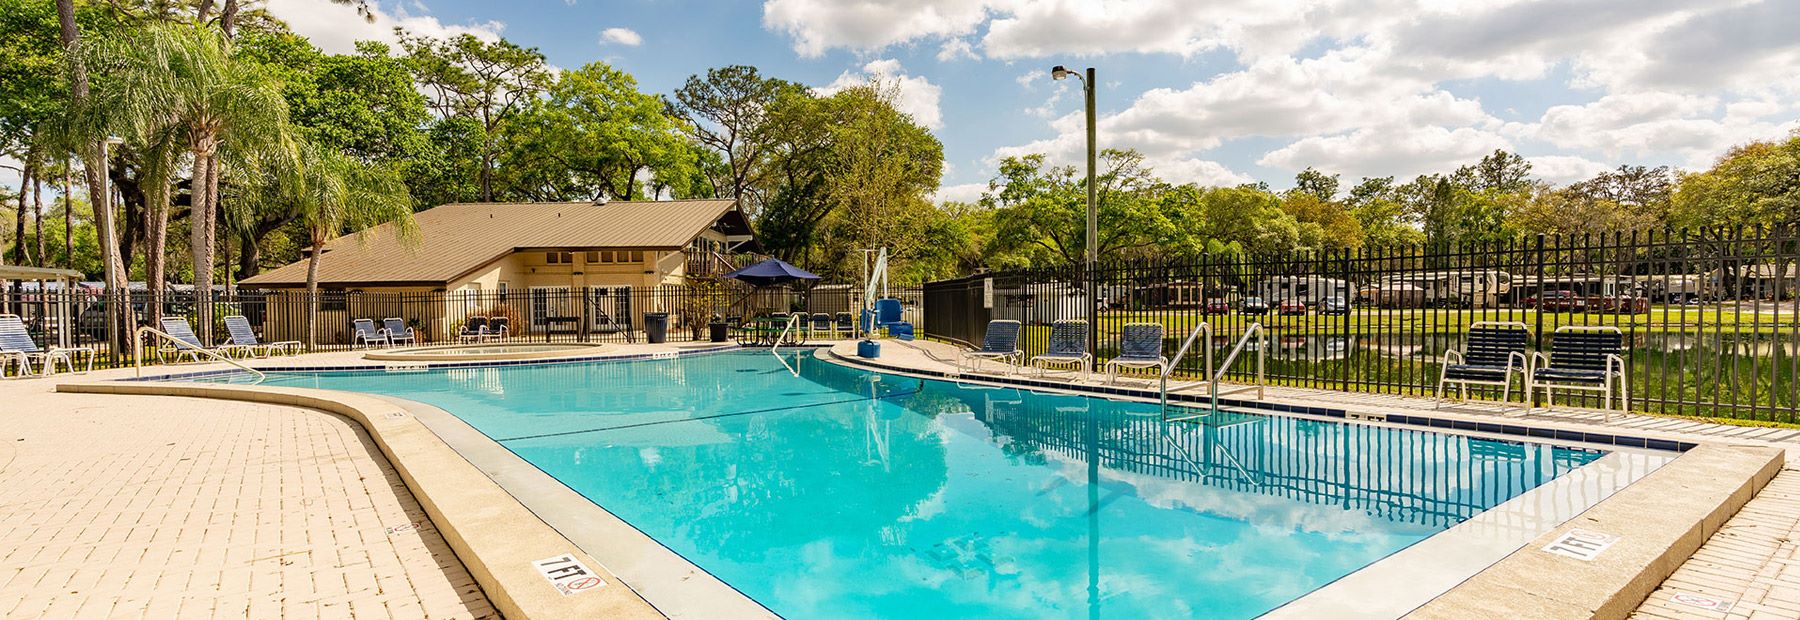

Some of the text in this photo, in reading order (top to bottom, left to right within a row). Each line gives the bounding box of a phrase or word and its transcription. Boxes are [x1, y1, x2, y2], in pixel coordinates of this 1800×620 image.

[1550, 545, 1588, 557] 7
[1560, 536, 1602, 551] FT
[540, 556, 588, 581] 7 FT
